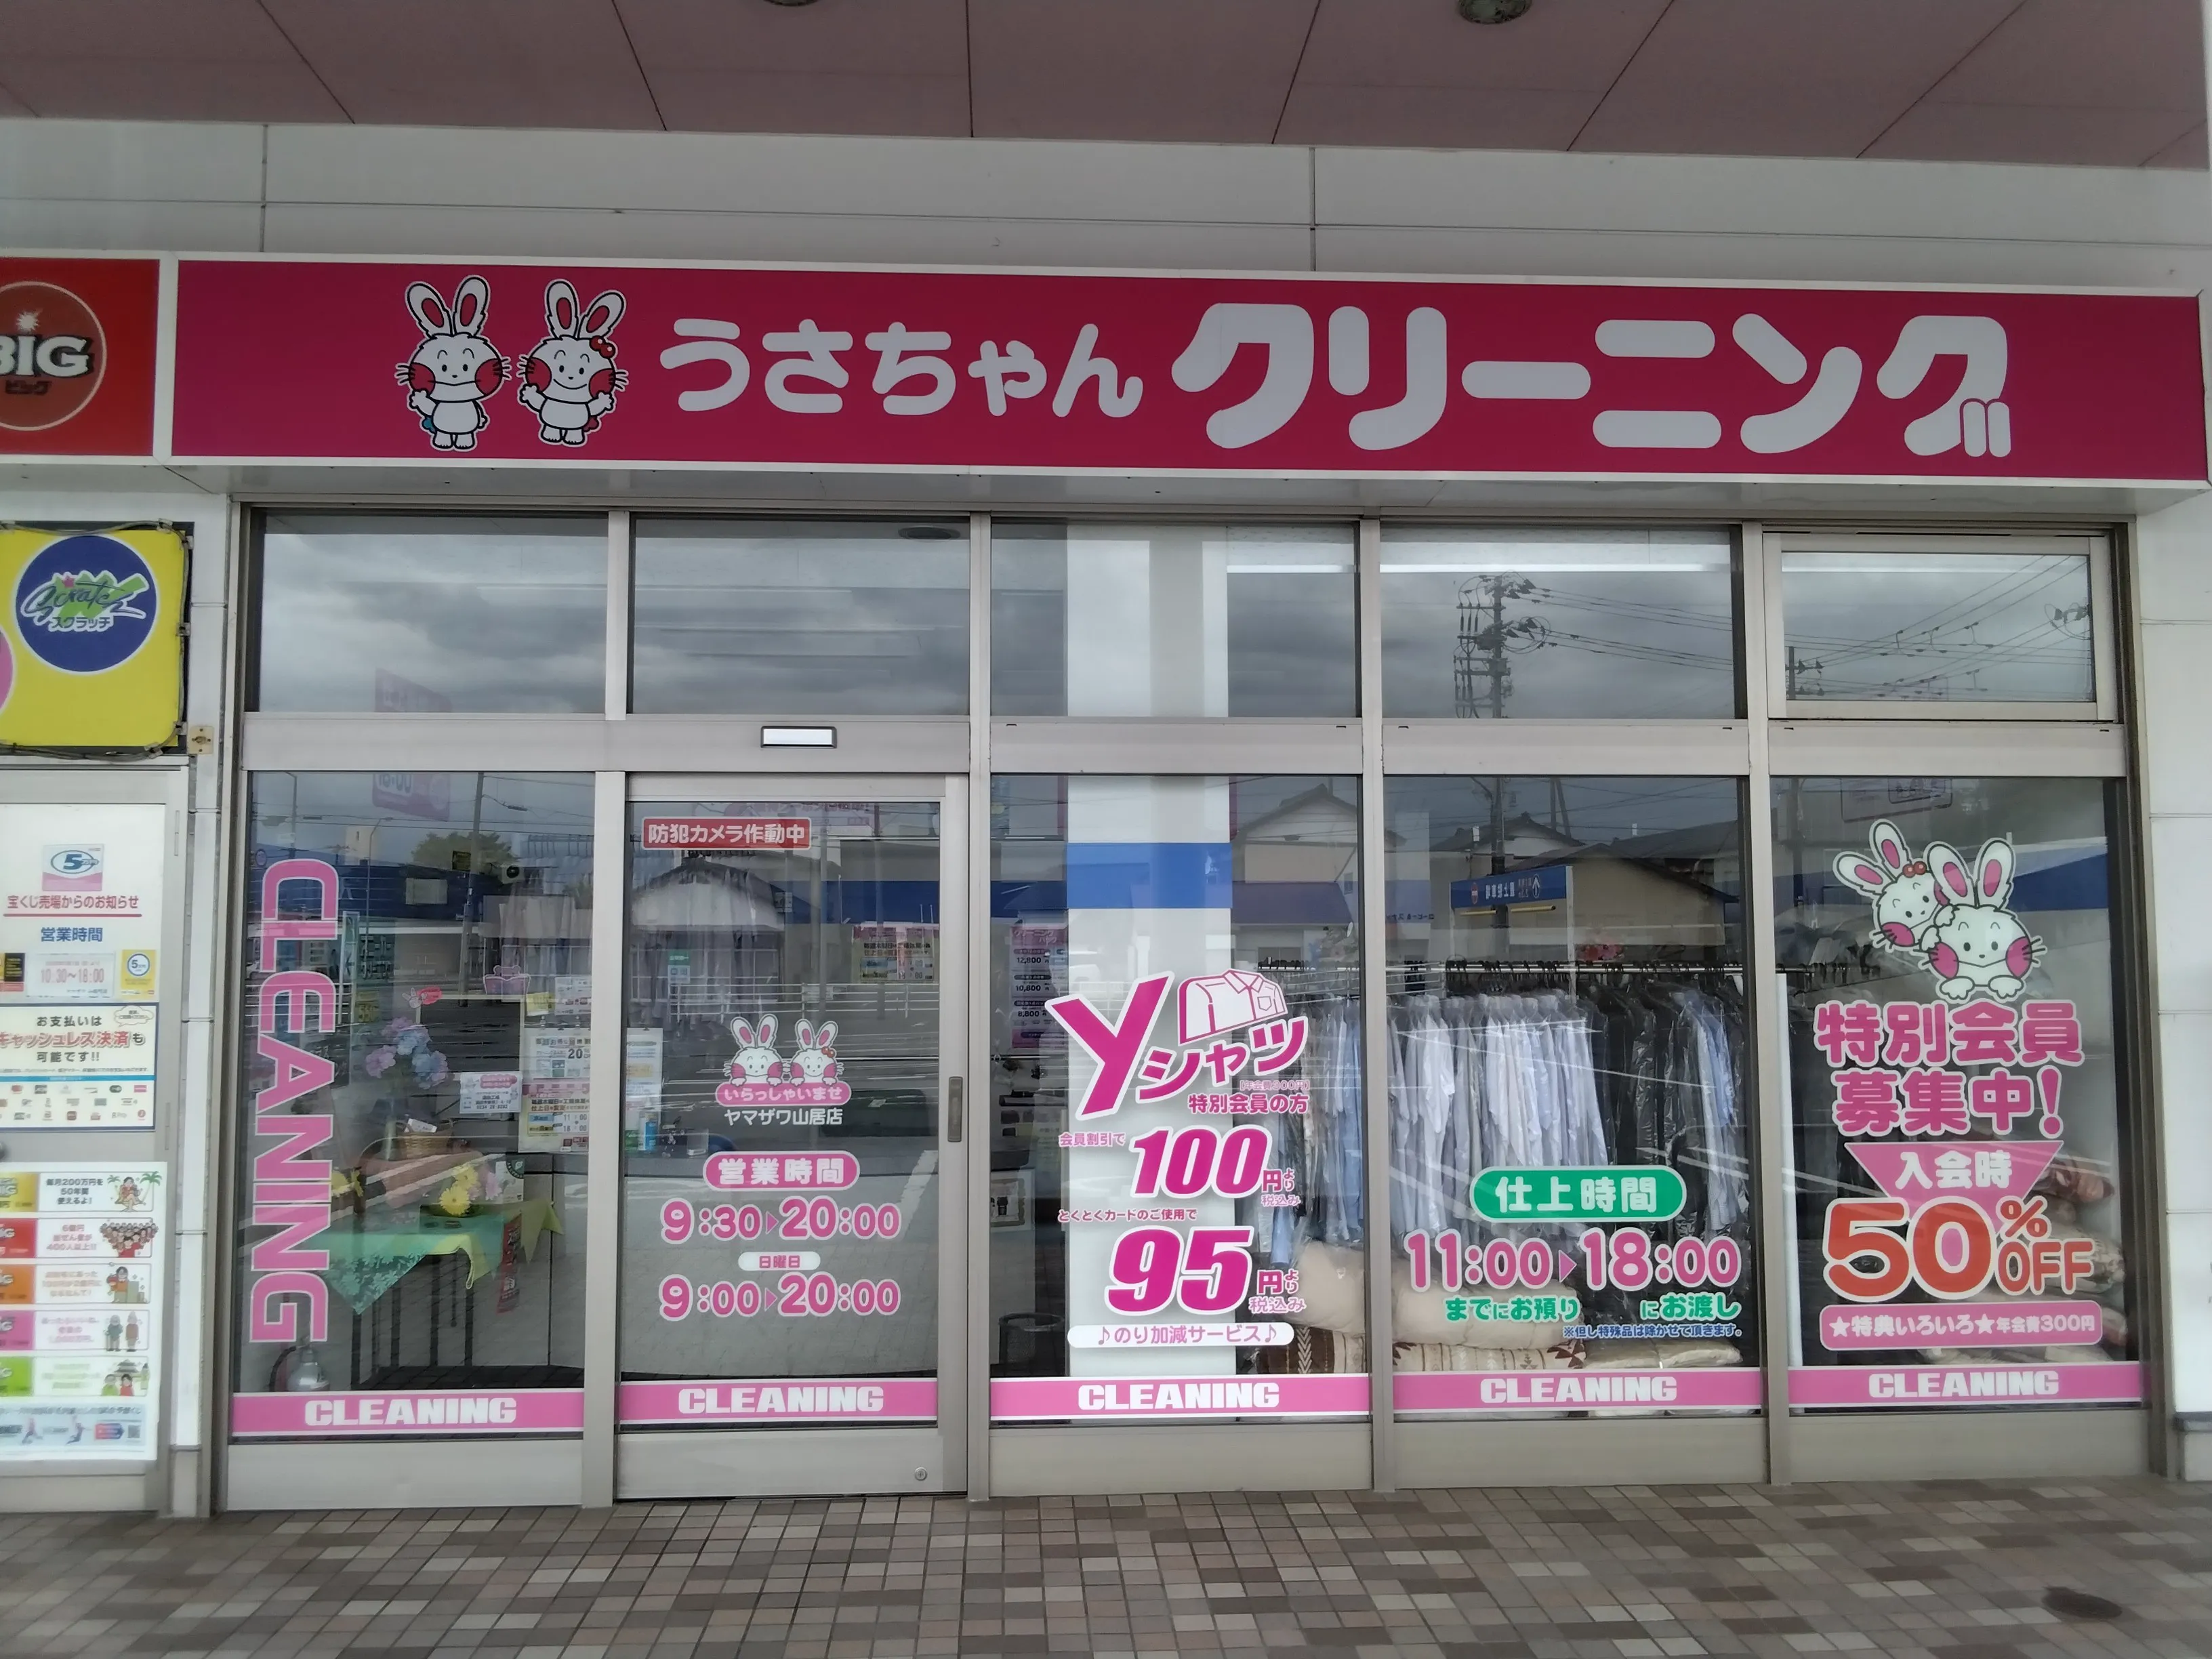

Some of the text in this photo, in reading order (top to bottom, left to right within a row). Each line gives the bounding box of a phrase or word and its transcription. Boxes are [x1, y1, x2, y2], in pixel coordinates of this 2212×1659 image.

[660, 303, 2011, 458] うさちゃん クリーニング
[52, 616, 111, 630] スクラッチ
[648, 823, 806, 845] 防犯カメラ作動中
[7, 895, 139, 909] 宝くじ売場からのお知らせ
[41, 927, 103, 943] 営業時間
[36, 1016, 102, 1027] お支払いは
[1814, 999, 2085, 1067] 特別会員
[0, 1031, 146, 1048] キャッシュレス決済も
[1045, 970, 1309, 1121] Yシャツ
[36, 1050, 100, 1063] 可能です!!
[249, 858, 339, 1343] CLEANING
[723, 1086, 842, 1101] いらっしゃいませ
[1187, 1092, 1310, 1114] 特別会員の方
[1831, 1065, 2064, 1139] 募集中!
[724, 1107, 843, 1126] ヤマザワ山居店
[1059, 1132, 1125, 1147] 会員割引で
[718, 1157, 844, 1185] 営業時間
[1894, 1149, 2013, 1189] 入会時
[1261, 1193, 1302, 1207] 税込み
[1494, 1175, 1657, 1213] 仕上時間
[661, 1195, 901, 1244] 9:30 20:00
[1057, 1208, 1197, 1223] とくとくカードのご使用で
[758, 1255, 801, 1269] 日曜日
[1404, 1227, 1742, 1292] 11:00 18:00
[1995, 1237, 2095, 1296] OFF
[659, 1271, 901, 1321] 9:00 20:00
[1248, 1296, 1307, 1313] 税込み
[1445, 1291, 1742, 1322] までにお預り にお渡し
[1996, 1314, 2095, 1332] 年会費300円
[1078, 1382, 1279, 1410] CLEANING
[1480, 1376, 1677, 1404] CLEANING
[1868, 1370, 2060, 1398] CLEANING
[304, 1397, 516, 1427] CLEANING
[678, 1386, 884, 1414] CLEANING
